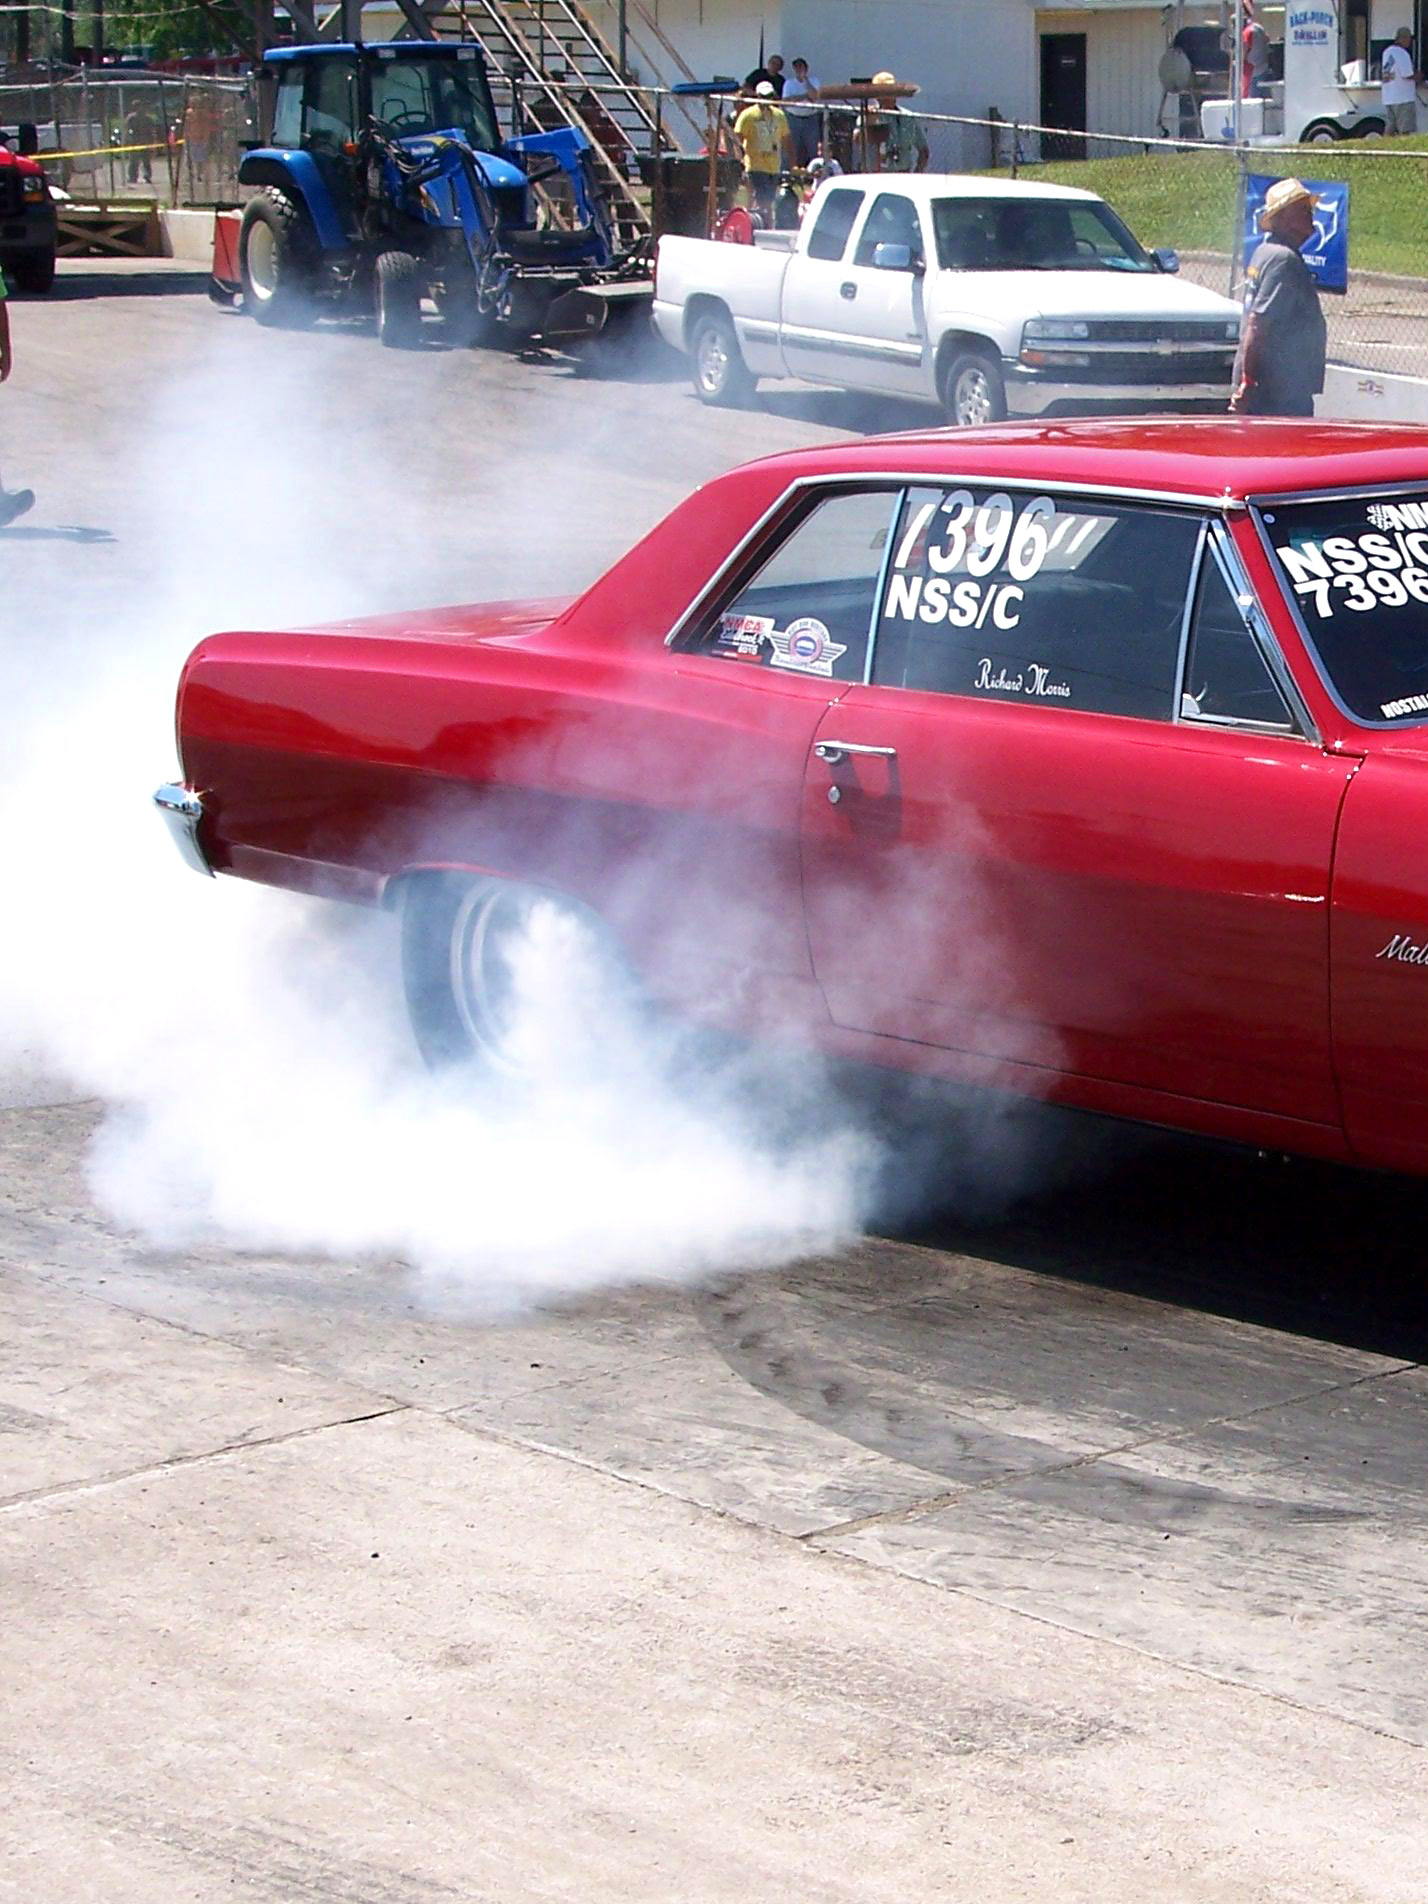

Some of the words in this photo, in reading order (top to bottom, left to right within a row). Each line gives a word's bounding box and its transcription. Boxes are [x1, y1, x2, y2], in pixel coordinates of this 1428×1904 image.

[1302, 254, 1327, 267] UALITY
[884, 574, 1024, 630] NSS/C
[974, 658, 1023, 690] Richard
[1025, 663, 1071, 697] Morris
